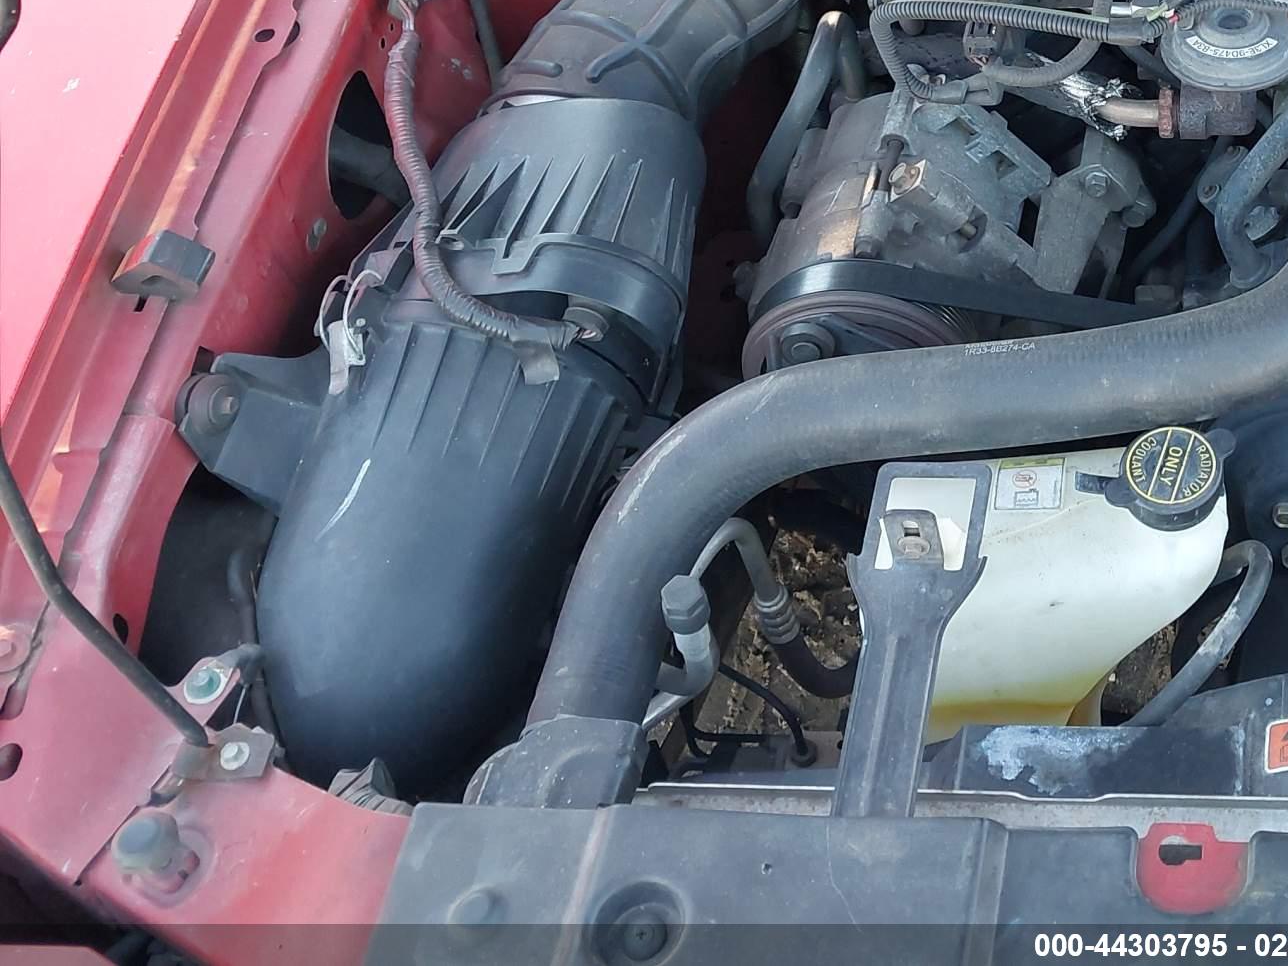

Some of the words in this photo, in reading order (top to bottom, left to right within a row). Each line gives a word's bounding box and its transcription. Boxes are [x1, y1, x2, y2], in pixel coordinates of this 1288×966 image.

[1192, 38, 1273, 58] XL3E-9D475-B3A
[1131, 436, 1157, 483] COOLANT
[1159, 446, 1183, 487] ONLY
[1182, 444, 1211, 497] RADIATOR
